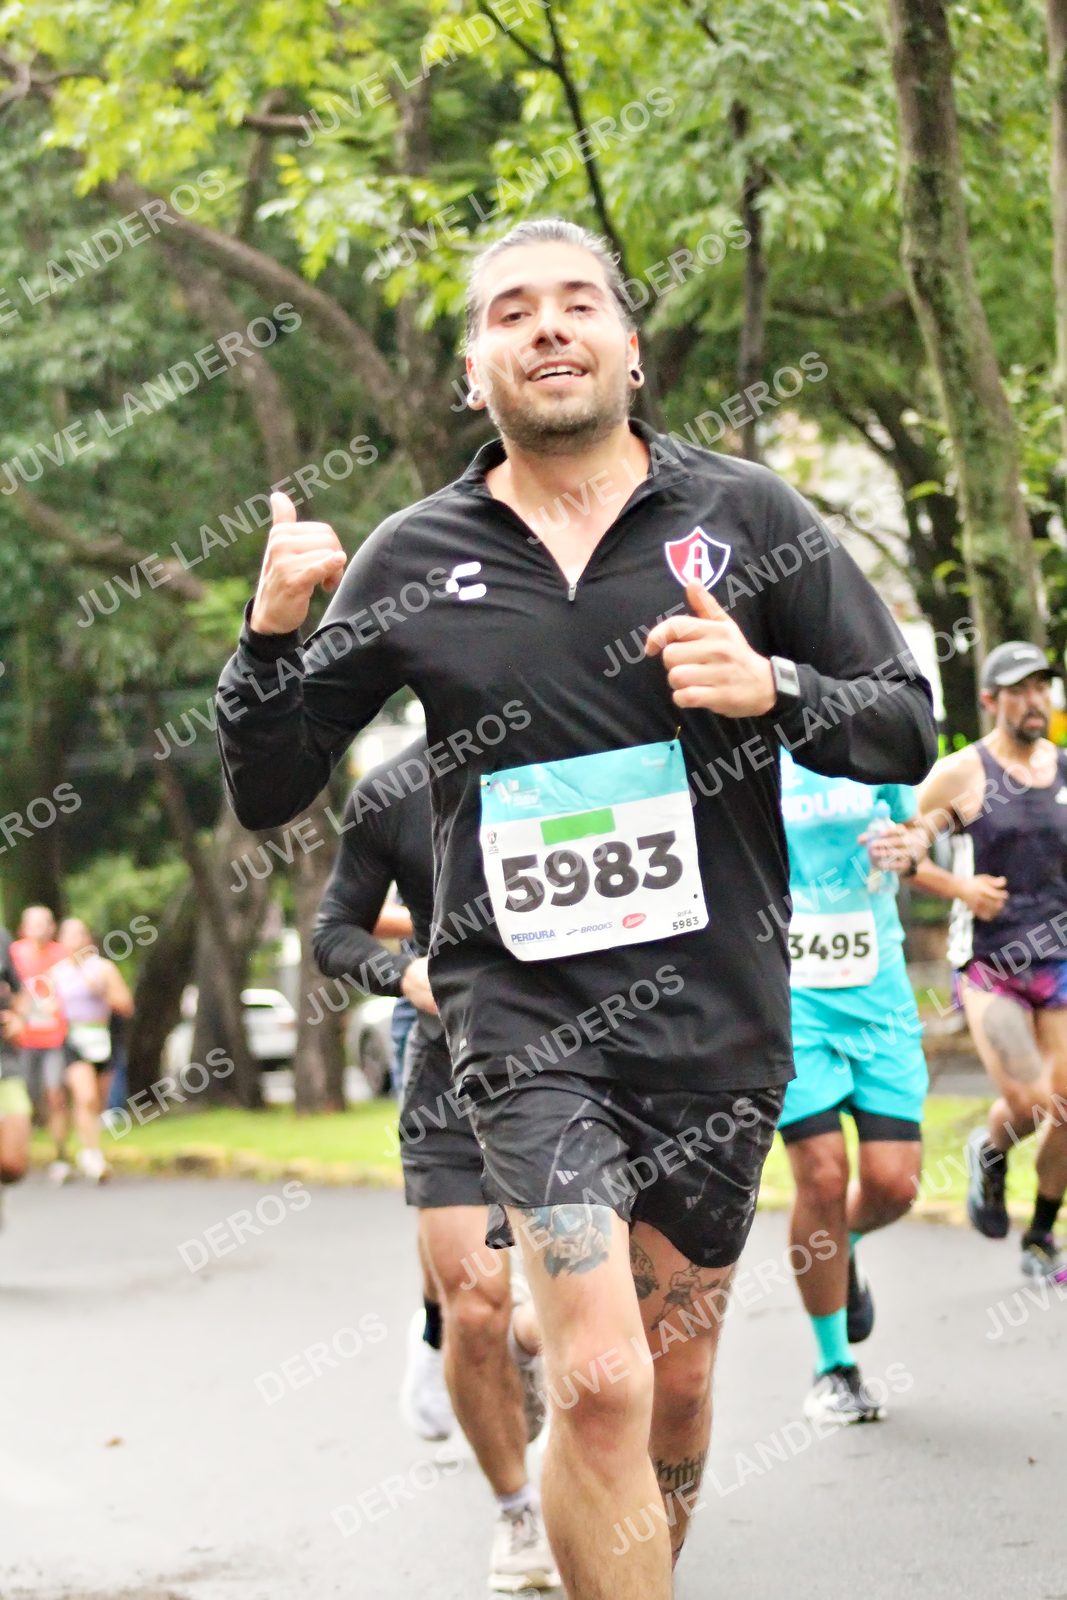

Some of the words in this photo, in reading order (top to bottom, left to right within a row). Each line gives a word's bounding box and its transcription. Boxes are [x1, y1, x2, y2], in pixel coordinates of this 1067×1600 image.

[501, 830, 684, 912] 5983
[511, 929, 556, 943] PERDURA
[580, 921, 613, 934] BROOKS
[672, 916, 700, 930] 5983
[788, 932, 870, 960] 3495
